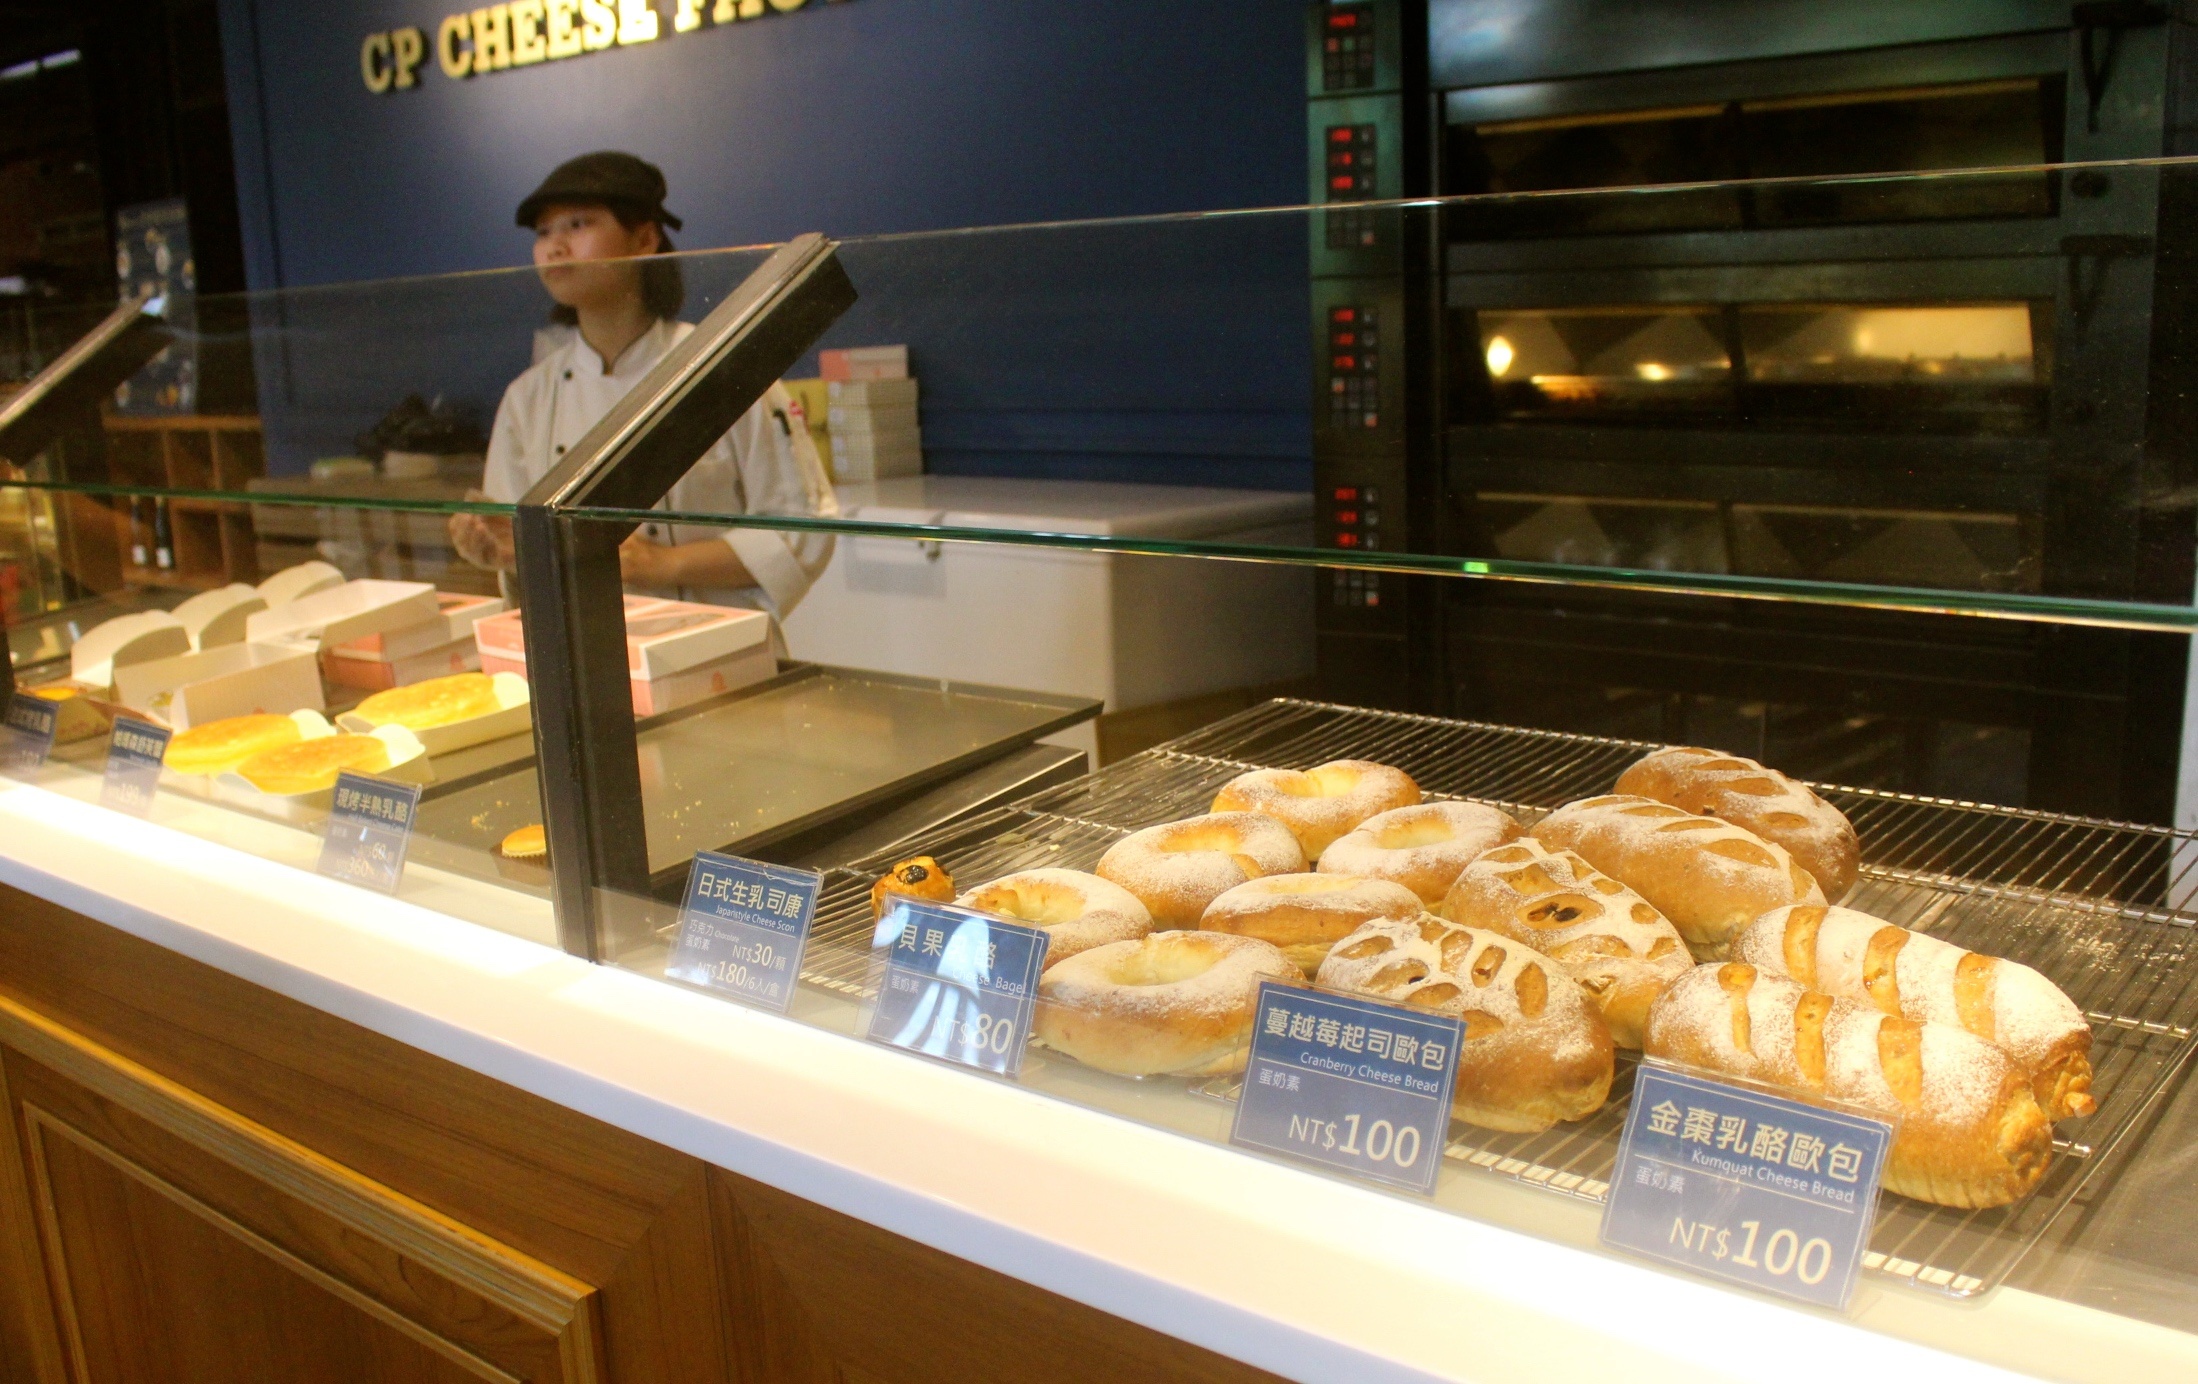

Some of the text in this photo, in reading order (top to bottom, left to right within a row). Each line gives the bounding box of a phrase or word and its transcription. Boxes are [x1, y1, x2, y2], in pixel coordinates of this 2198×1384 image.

[360, 28, 424, 94] CP
[438, 0, 658, 78] CHEESE
[697, 872, 804, 919] 日式生乳司康
[751, 913, 777, 928] Cheese
[778, 919, 795, 933] Scon
[891, 975, 920, 994] 蛋奶素
[952, 969, 1026, 995] Cheese Bagel
[931, 1013, 1014, 1054] NT$80
[1264, 1007, 1446, 1071] 蔓越莓起司歐包
[1258, 1068, 1300, 1092] 蛋奶素
[1300, 1051, 1439, 1093] Cranberry Cheese Bread
[1288, 1113, 1421, 1169] NT$100
[1646, 1099, 1863, 1184] 金棗乳酪歐包
[1634, 1165, 1686, 1195] 蛋奶素
[1691, 1149, 1856, 1203] Kumquat Cheese Bread
[1668, 1217, 1833, 1285] NT$100
